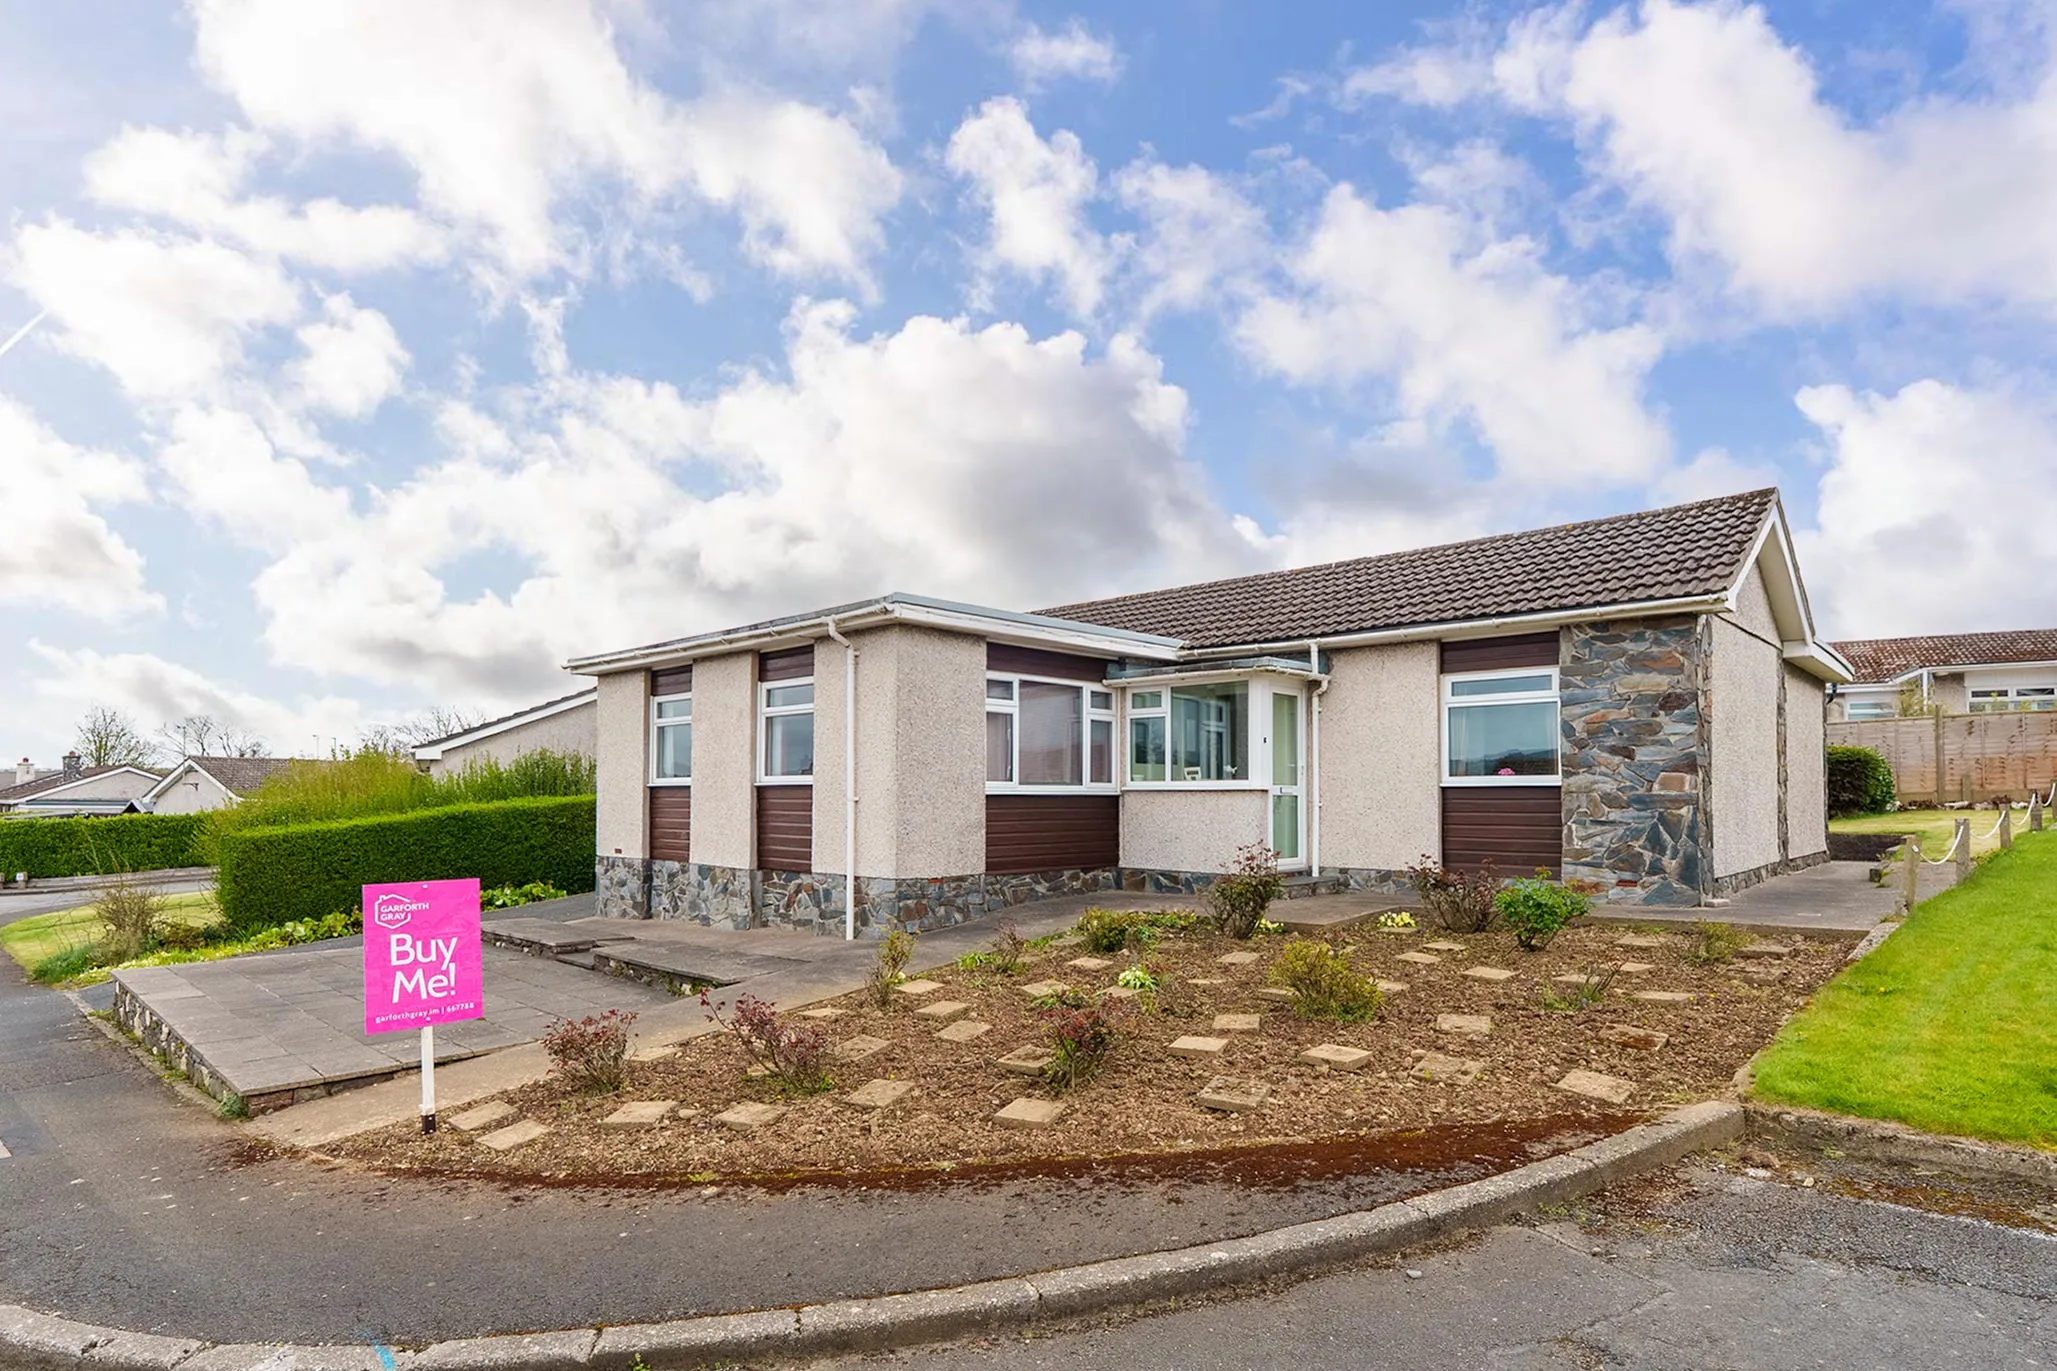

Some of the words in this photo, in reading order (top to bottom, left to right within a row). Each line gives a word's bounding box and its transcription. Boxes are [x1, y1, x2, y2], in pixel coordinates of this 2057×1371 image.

[380, 902, 430, 913] GARFORTH
[380, 912, 407, 921] GRAY
[390, 933, 458, 971] Buy
[392, 962, 456, 1004] Me!
[375, 1008, 440, 1024] garforthgray.im
